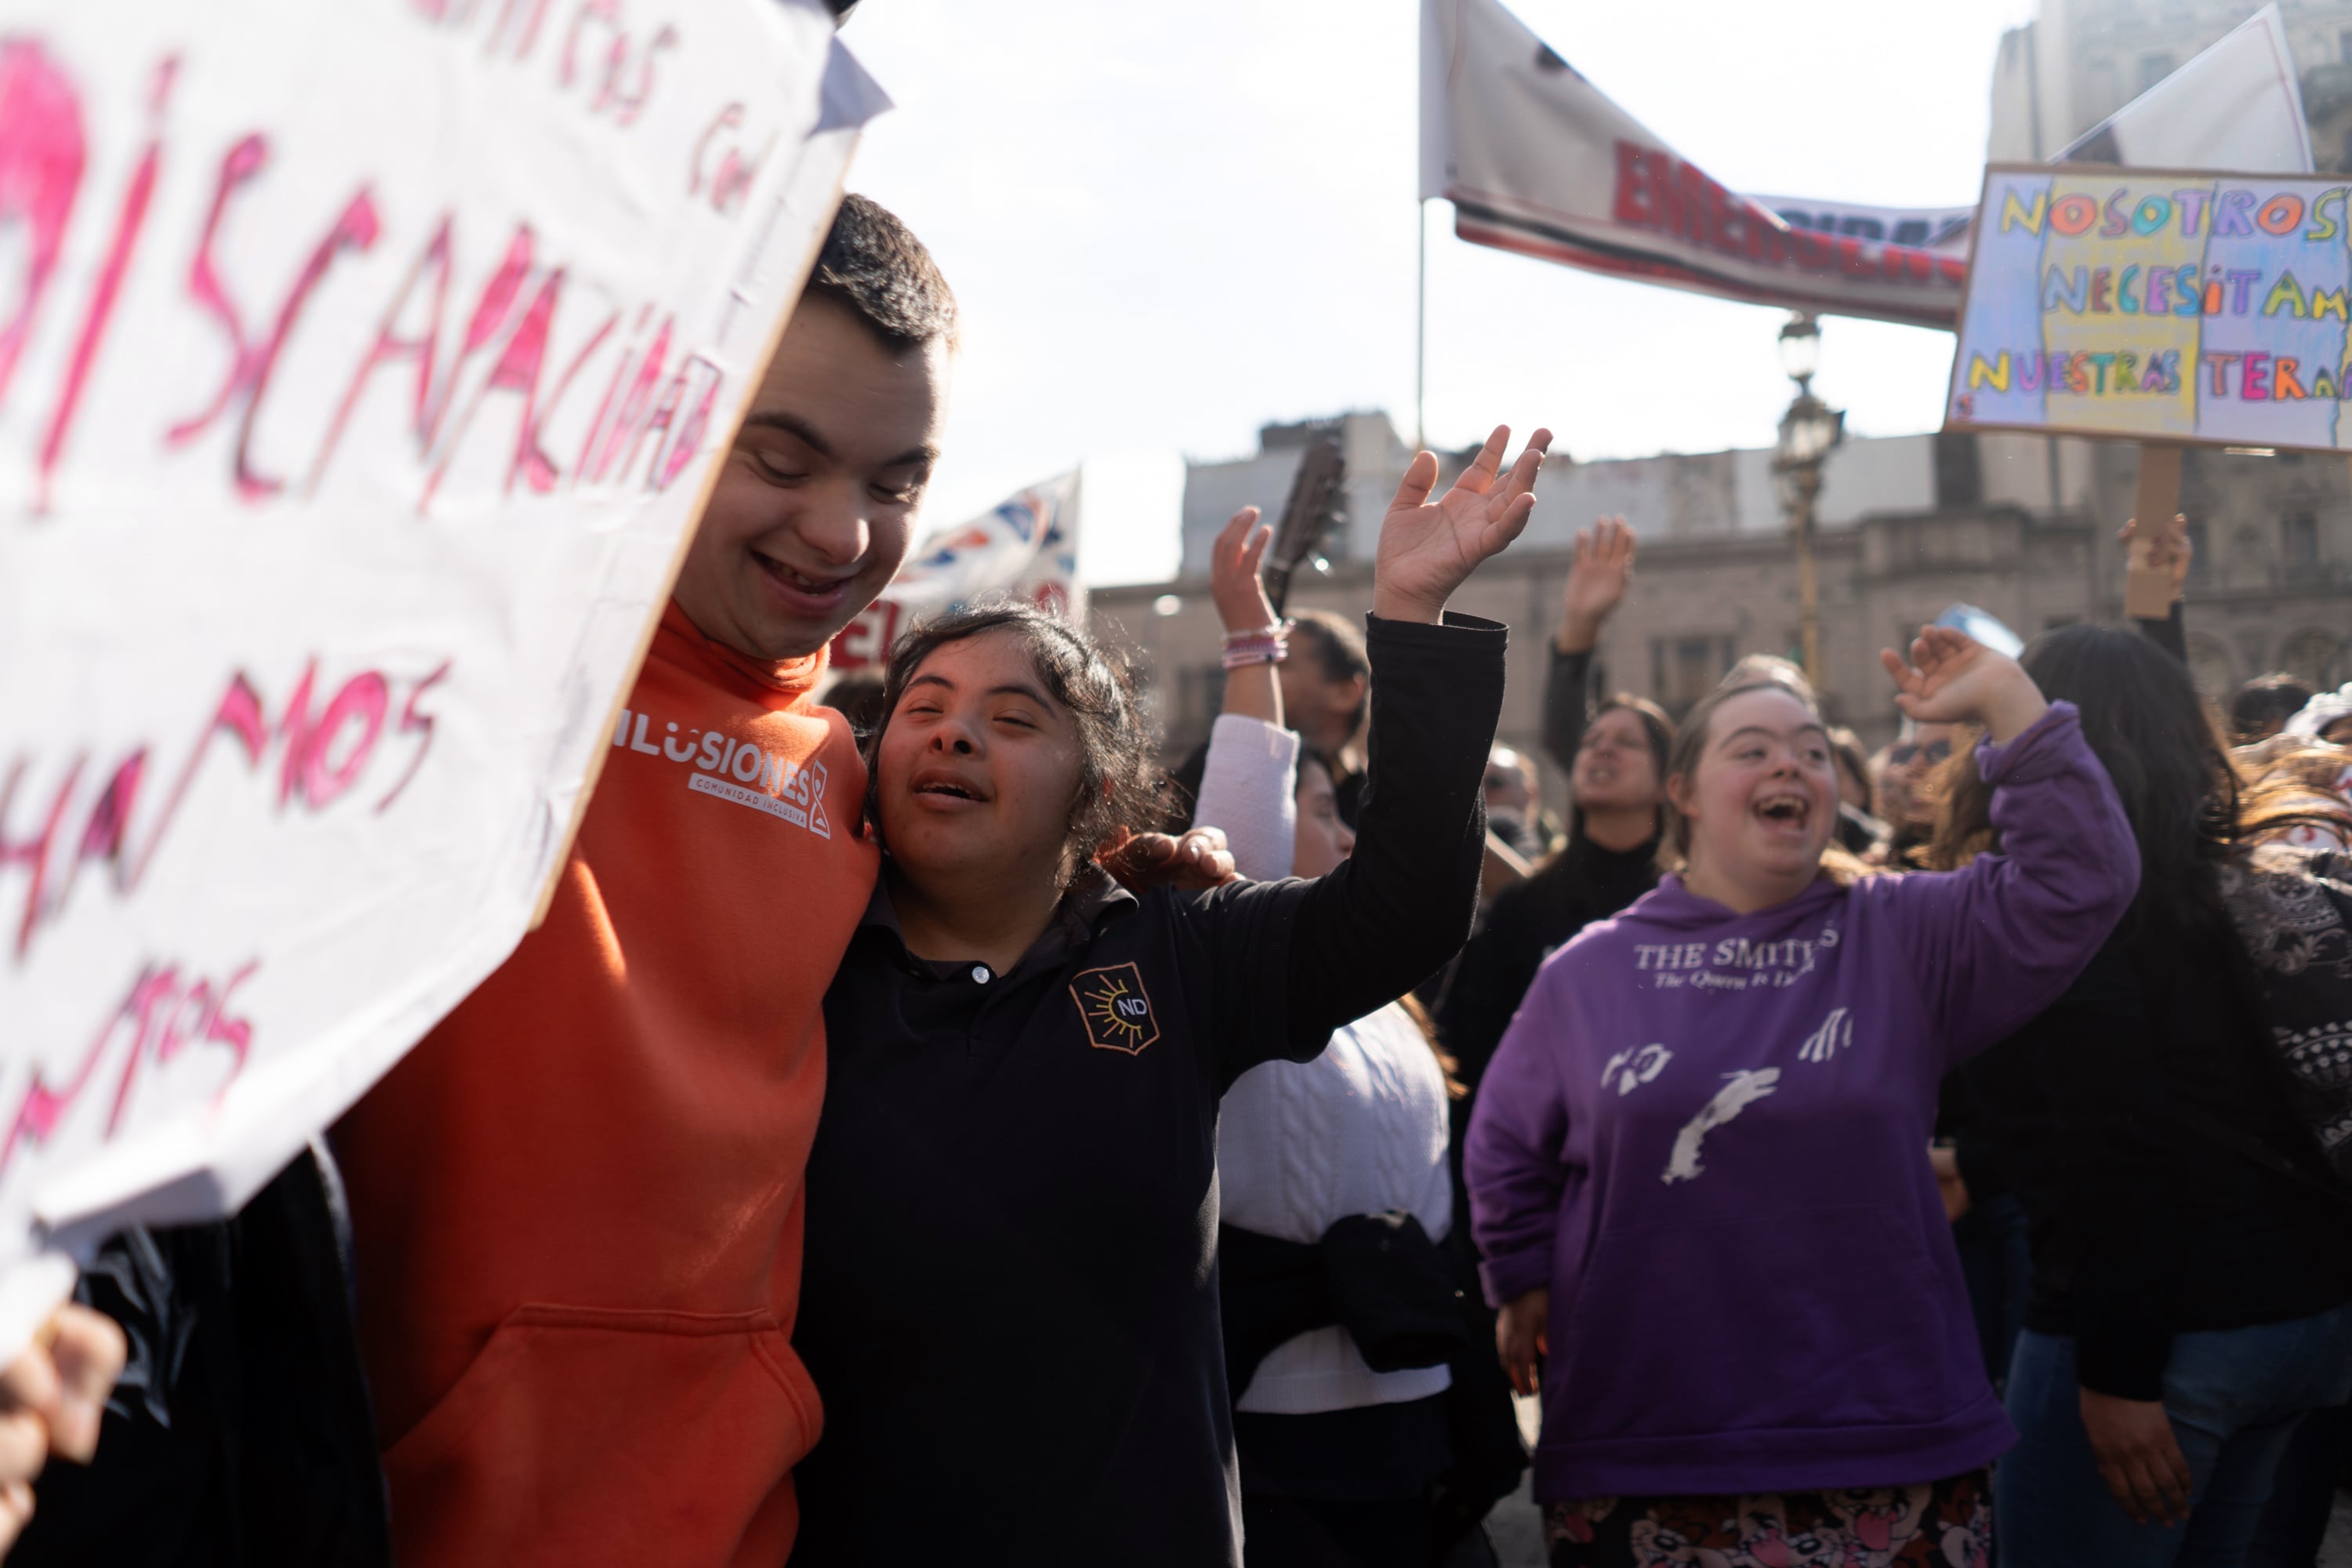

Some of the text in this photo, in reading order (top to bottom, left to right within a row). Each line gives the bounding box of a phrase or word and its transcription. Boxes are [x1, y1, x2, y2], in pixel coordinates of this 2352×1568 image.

[2000, 185, 2347, 242] NOSOTROS
[1967, 348, 2182, 396] NUESTRAS
[695, 778, 805, 824] COMUNIDAD INCLUSIVA
[1635, 942, 1707, 970] THE
[1116, 998, 1148, 1016] ND
